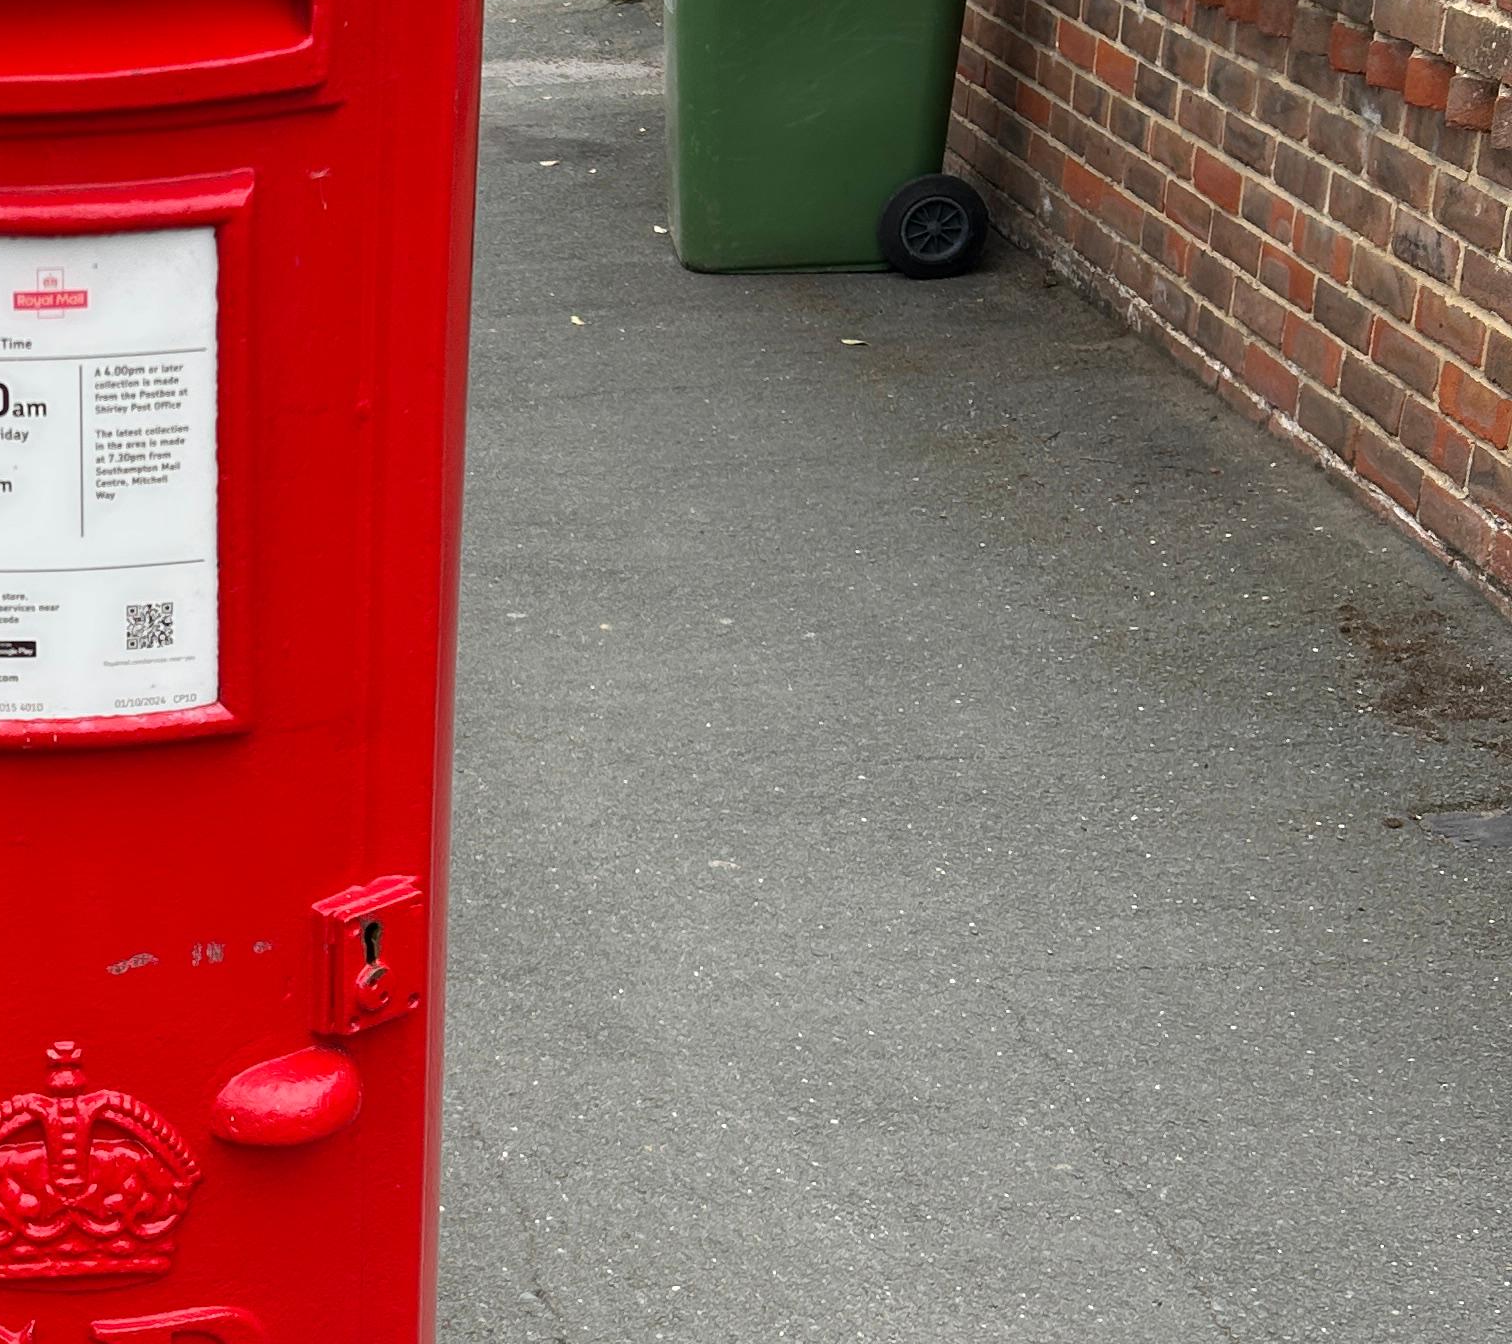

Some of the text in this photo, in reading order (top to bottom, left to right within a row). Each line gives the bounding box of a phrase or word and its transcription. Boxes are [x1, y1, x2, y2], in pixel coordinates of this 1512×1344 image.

[16, 293, 85, 309] Royal Mail
[0, 337, 33, 350] Time
[94, 364, 184, 377] A 4.00pm or later
[94, 376, 179, 390] collection is made
[95, 392, 118, 402] from
[120, 391, 136, 400] the
[178, 388, 188, 397] at
[95, 400, 182, 416] Shirley Post Office
[95, 425, 190, 439] The latest collection
[95, 436, 186, 451] in the area is made
[95, 456, 105, 465] at
[148, 451, 172, 460] from
[95, 462, 181, 477] Southampton Mail
[131, 475, 169, 486] Mitchell
[95, 490, 116, 501] Way
[38, 604, 60, 612] near
